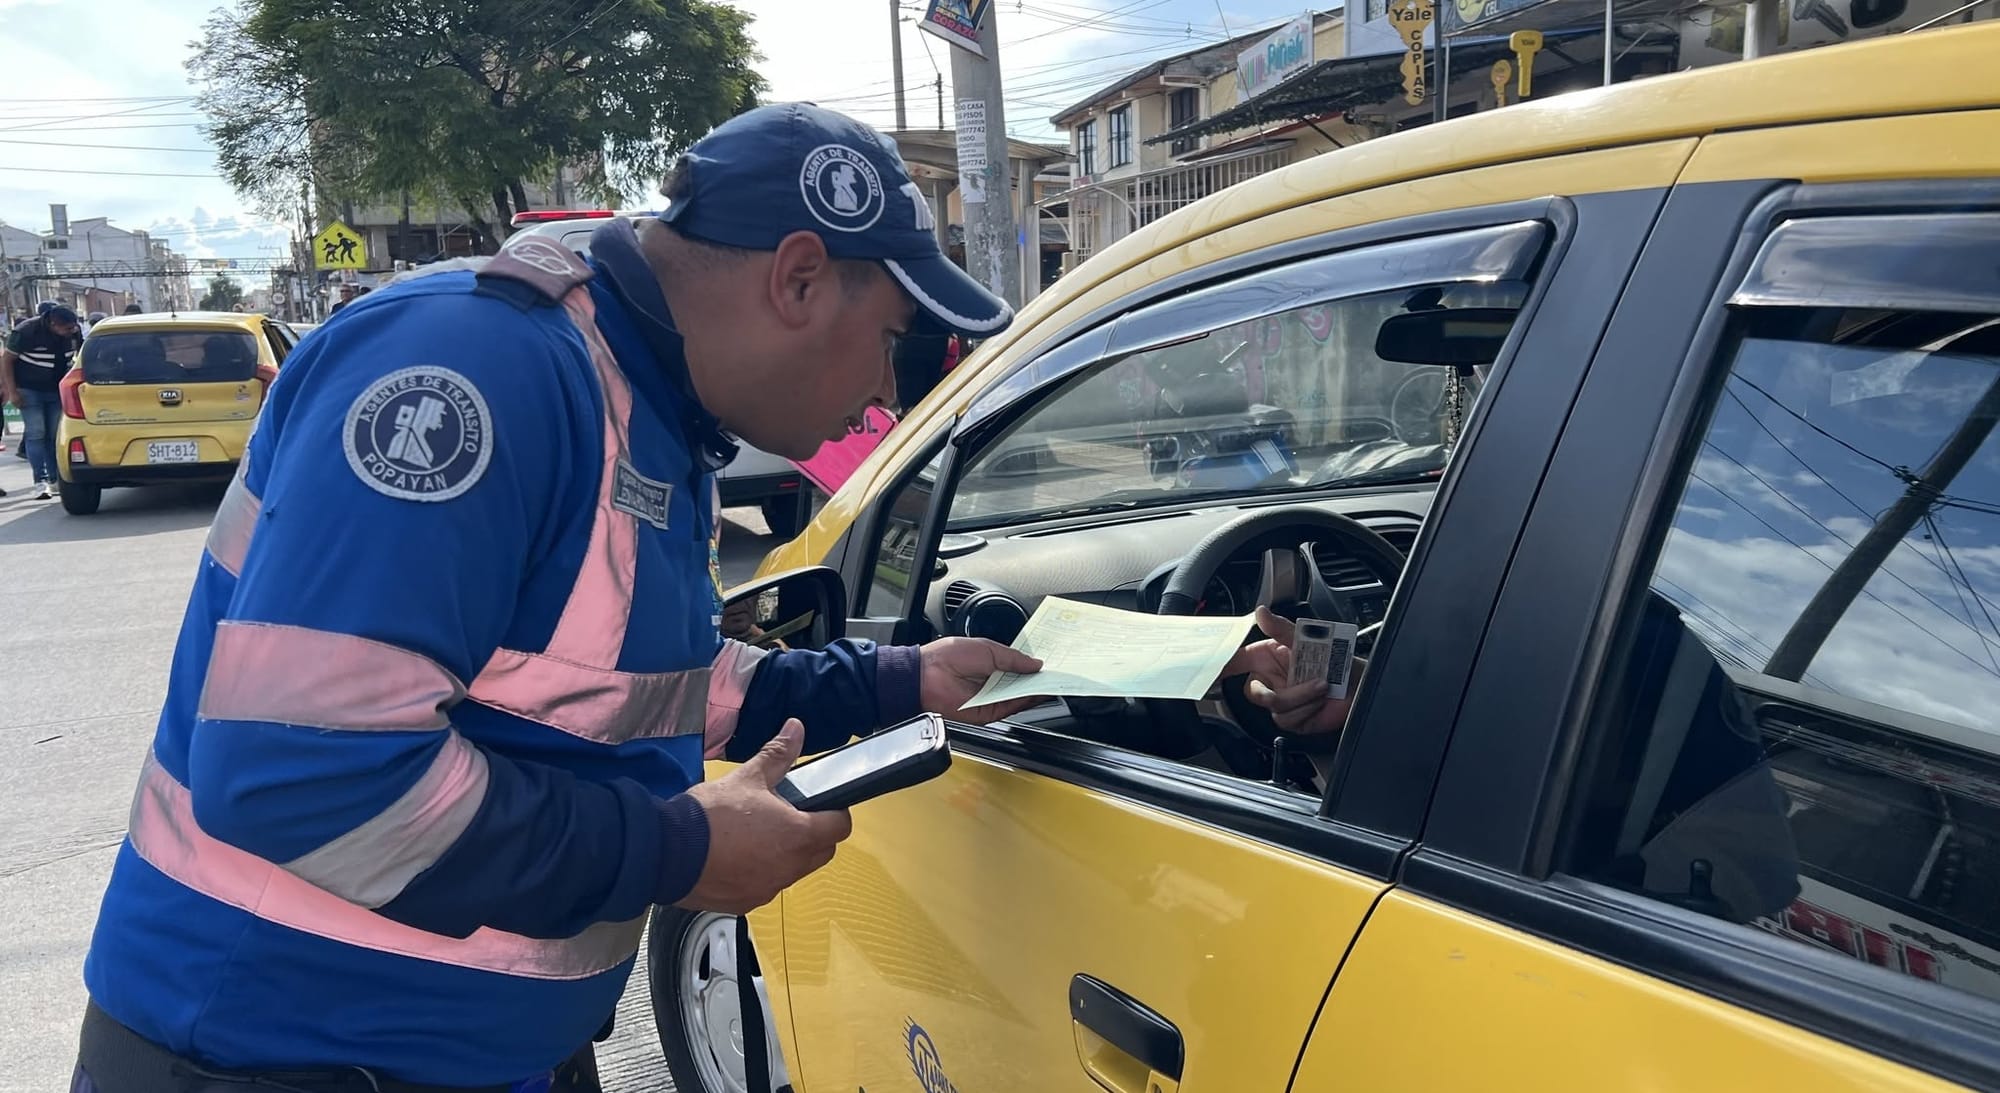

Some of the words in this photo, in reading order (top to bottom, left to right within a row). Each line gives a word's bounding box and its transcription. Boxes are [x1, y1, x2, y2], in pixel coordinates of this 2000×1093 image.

[1392, 8, 1432, 22] Yale
[1410, 30, 1425, 98] COPIAS
[963, 111, 984, 119] PISOS
[804, 150, 829, 187] AGENTE
[828, 148, 844, 159] DE
[846, 152, 880, 197] TRANSITO
[160, 391, 178, 399] KIA
[358, 376, 417, 423] AGENTES
[422, 375, 443, 389] DE
[444, 382, 480, 454] TRANSITO
[361, 452, 447, 491] POPAYAN
